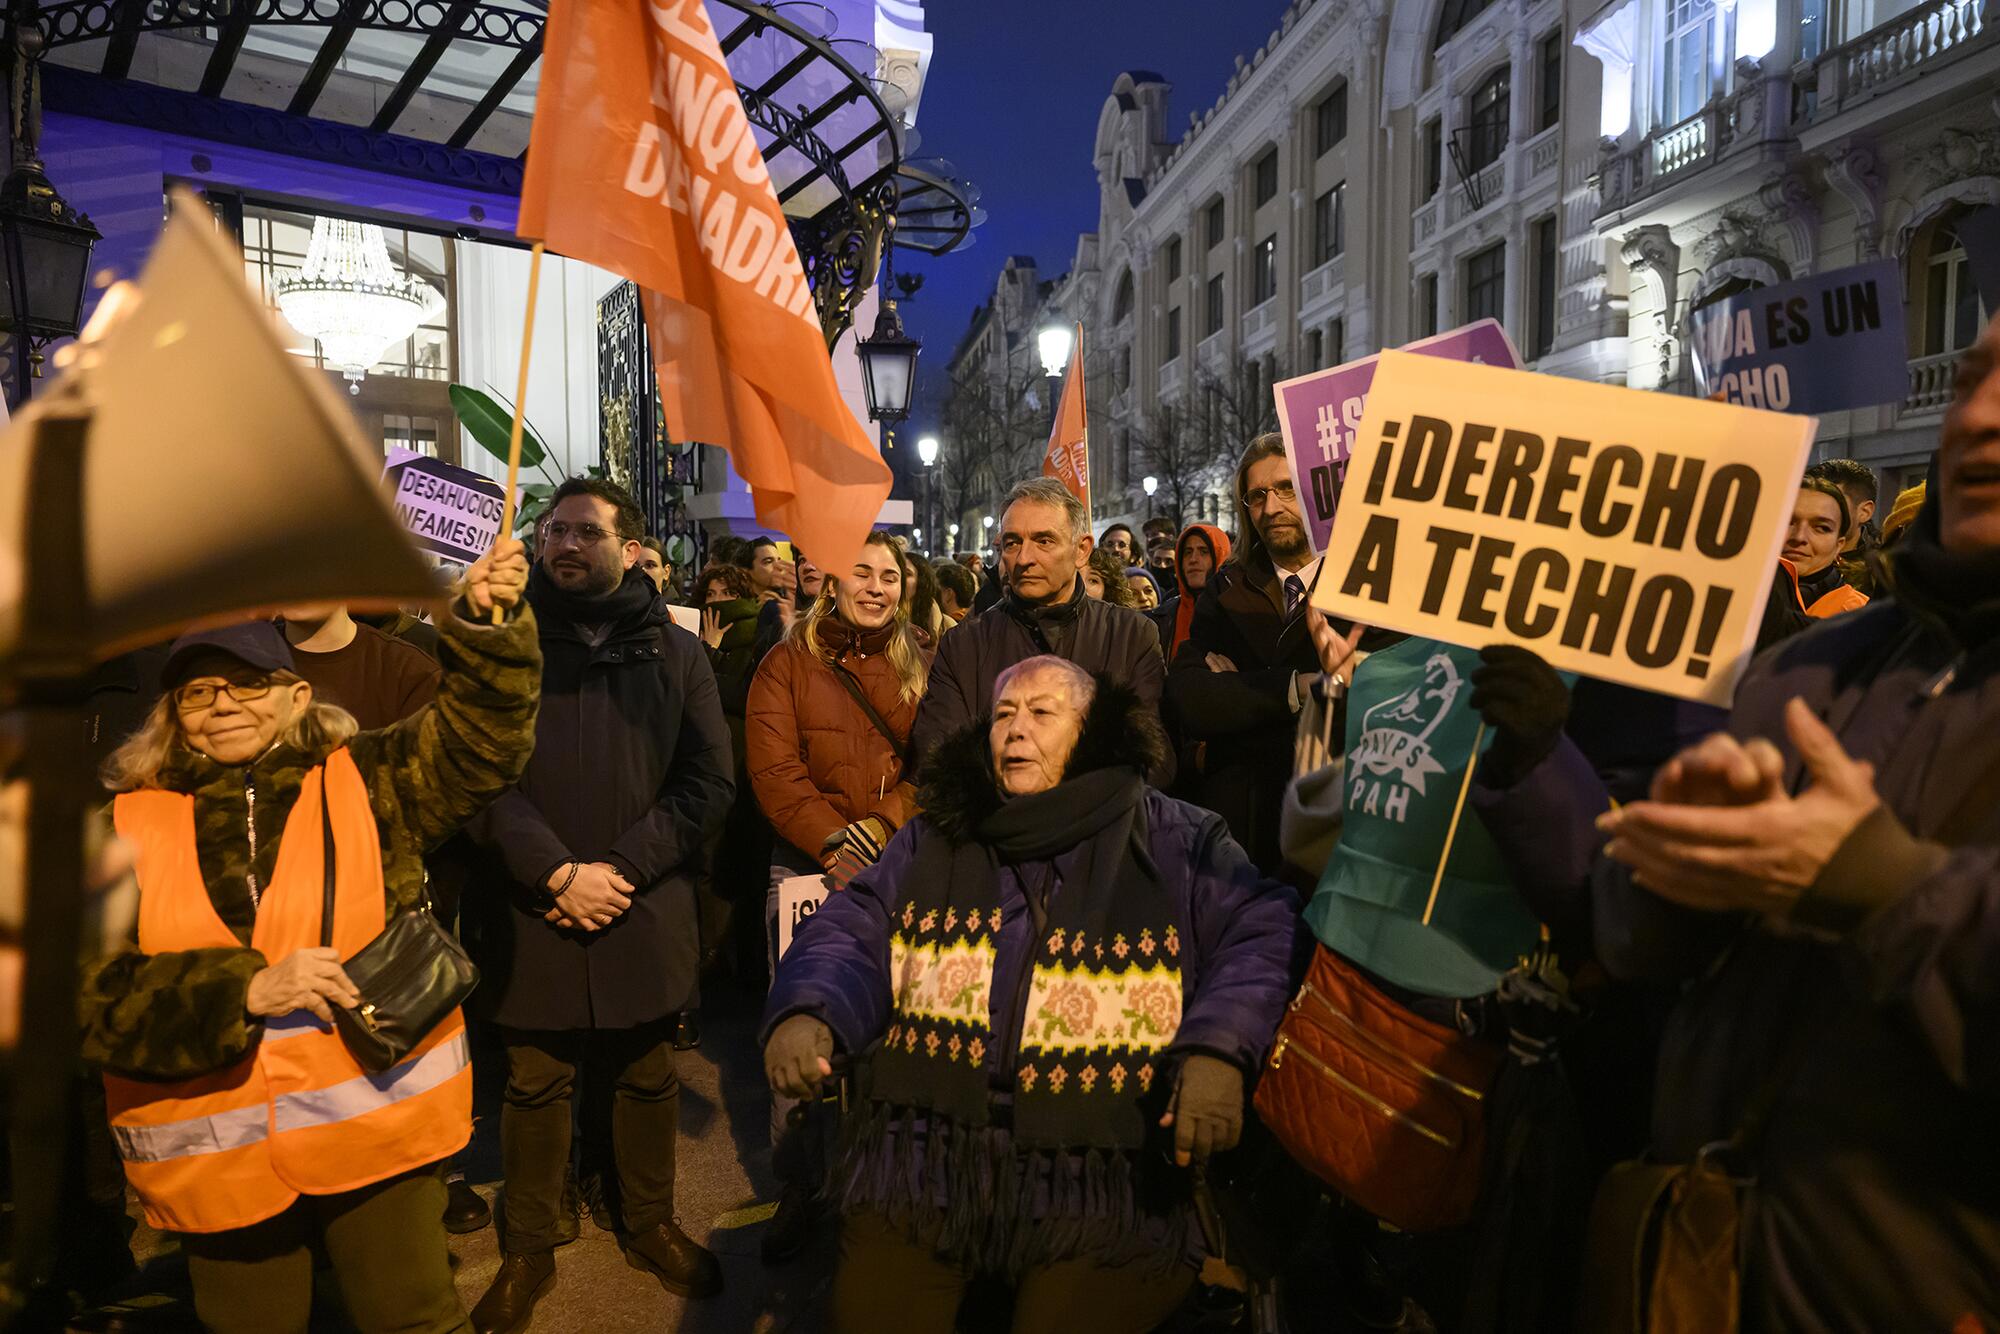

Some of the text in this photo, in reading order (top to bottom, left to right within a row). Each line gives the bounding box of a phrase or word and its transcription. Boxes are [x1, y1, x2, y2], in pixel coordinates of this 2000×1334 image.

[1765, 297, 1811, 350] ES
[1822, 280, 1881, 338] UN
[402, 471, 504, 523] DESAHUCIOS
[1362, 414, 1763, 561] ¡DERECHO
[1339, 513, 1735, 680] A TECHO!
[1348, 778, 1411, 824] PAH
